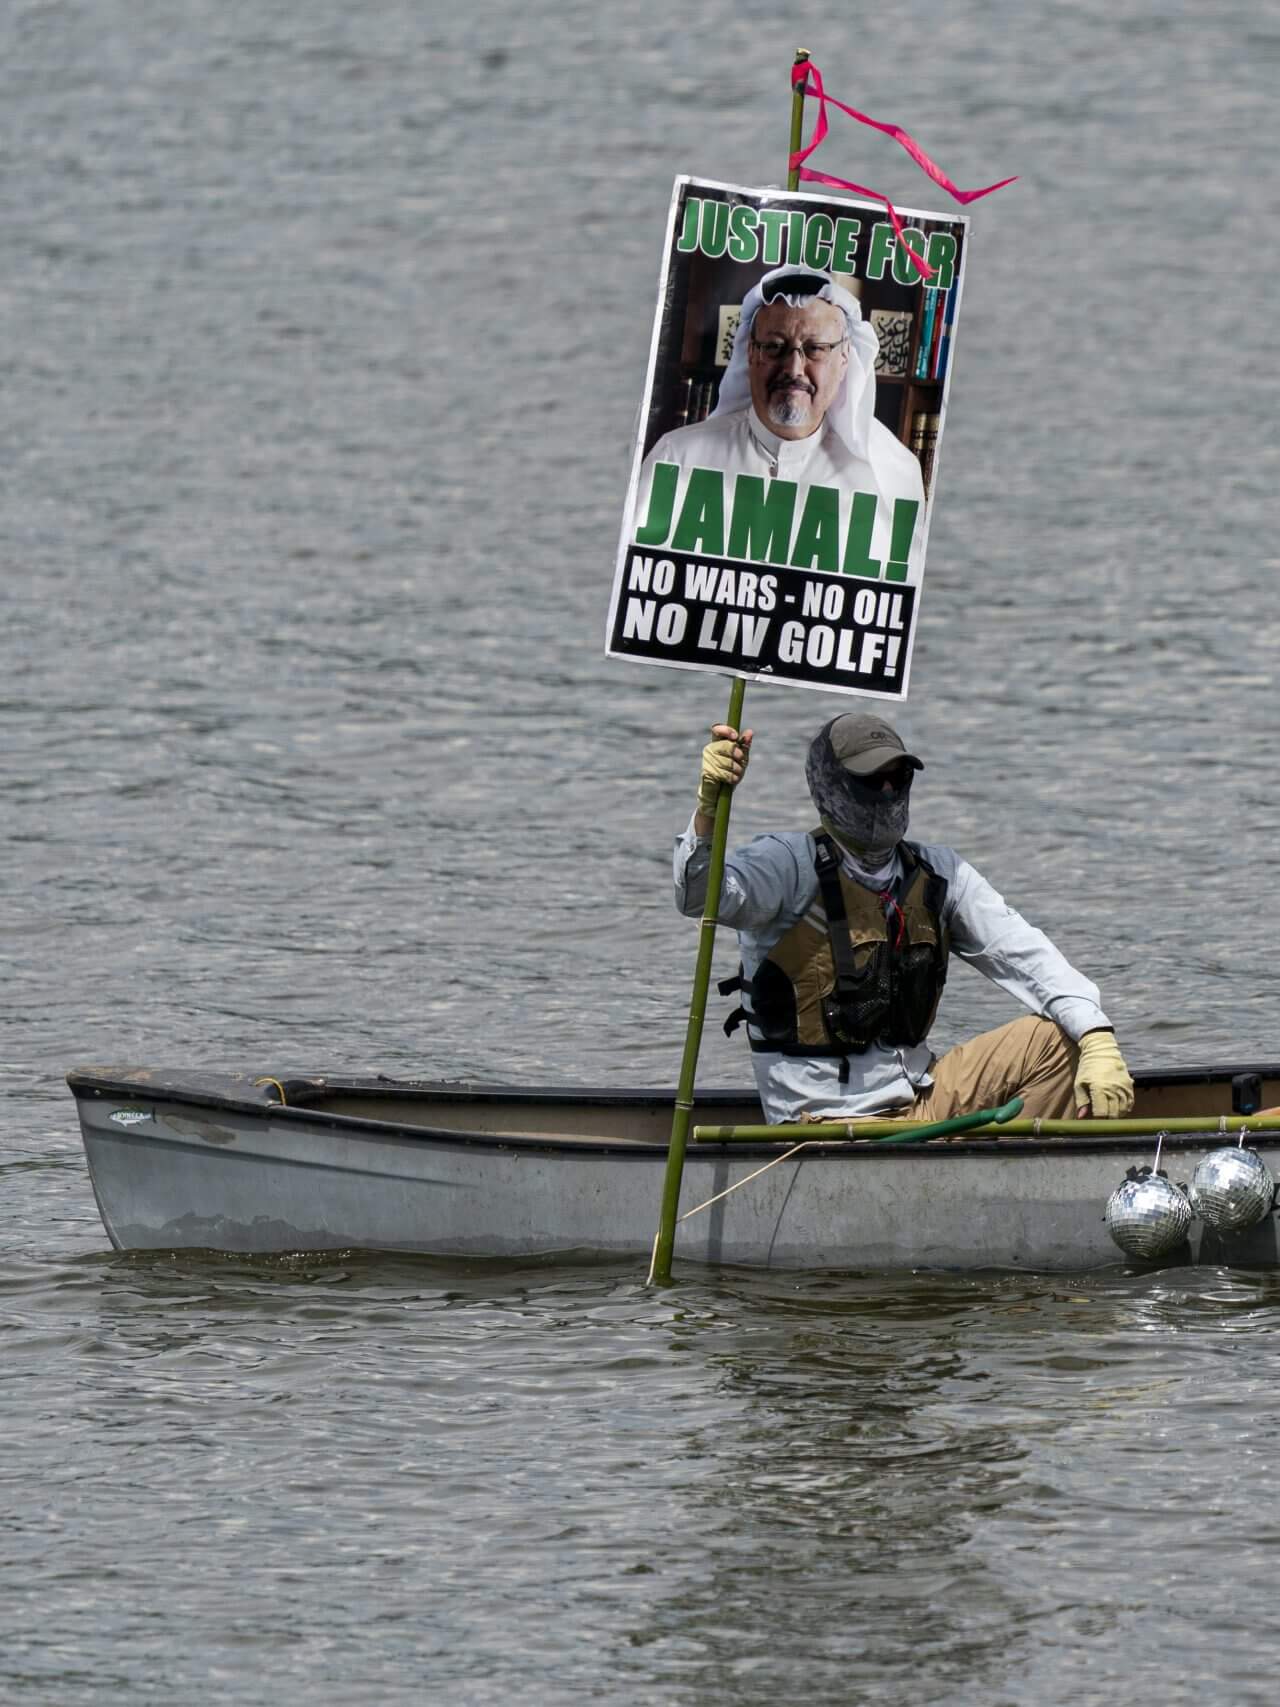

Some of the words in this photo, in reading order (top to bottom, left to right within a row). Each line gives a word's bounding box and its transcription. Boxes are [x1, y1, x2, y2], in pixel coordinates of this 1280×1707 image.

[677, 197, 862, 274] JUSTICE
[866, 222, 957, 289] FOR
[635, 462, 920, 583] JAMAL!
[628, 555, 676, 596] NO
[684, 563, 778, 611] WARS
[784, 594, 796, 604] -
[802, 581, 845, 620] NO
[853, 588, 904, 630] OIL
[622, 597, 688, 646] NO
[697, 608, 770, 658] LIV
[777, 621, 903, 677] GOLF!
